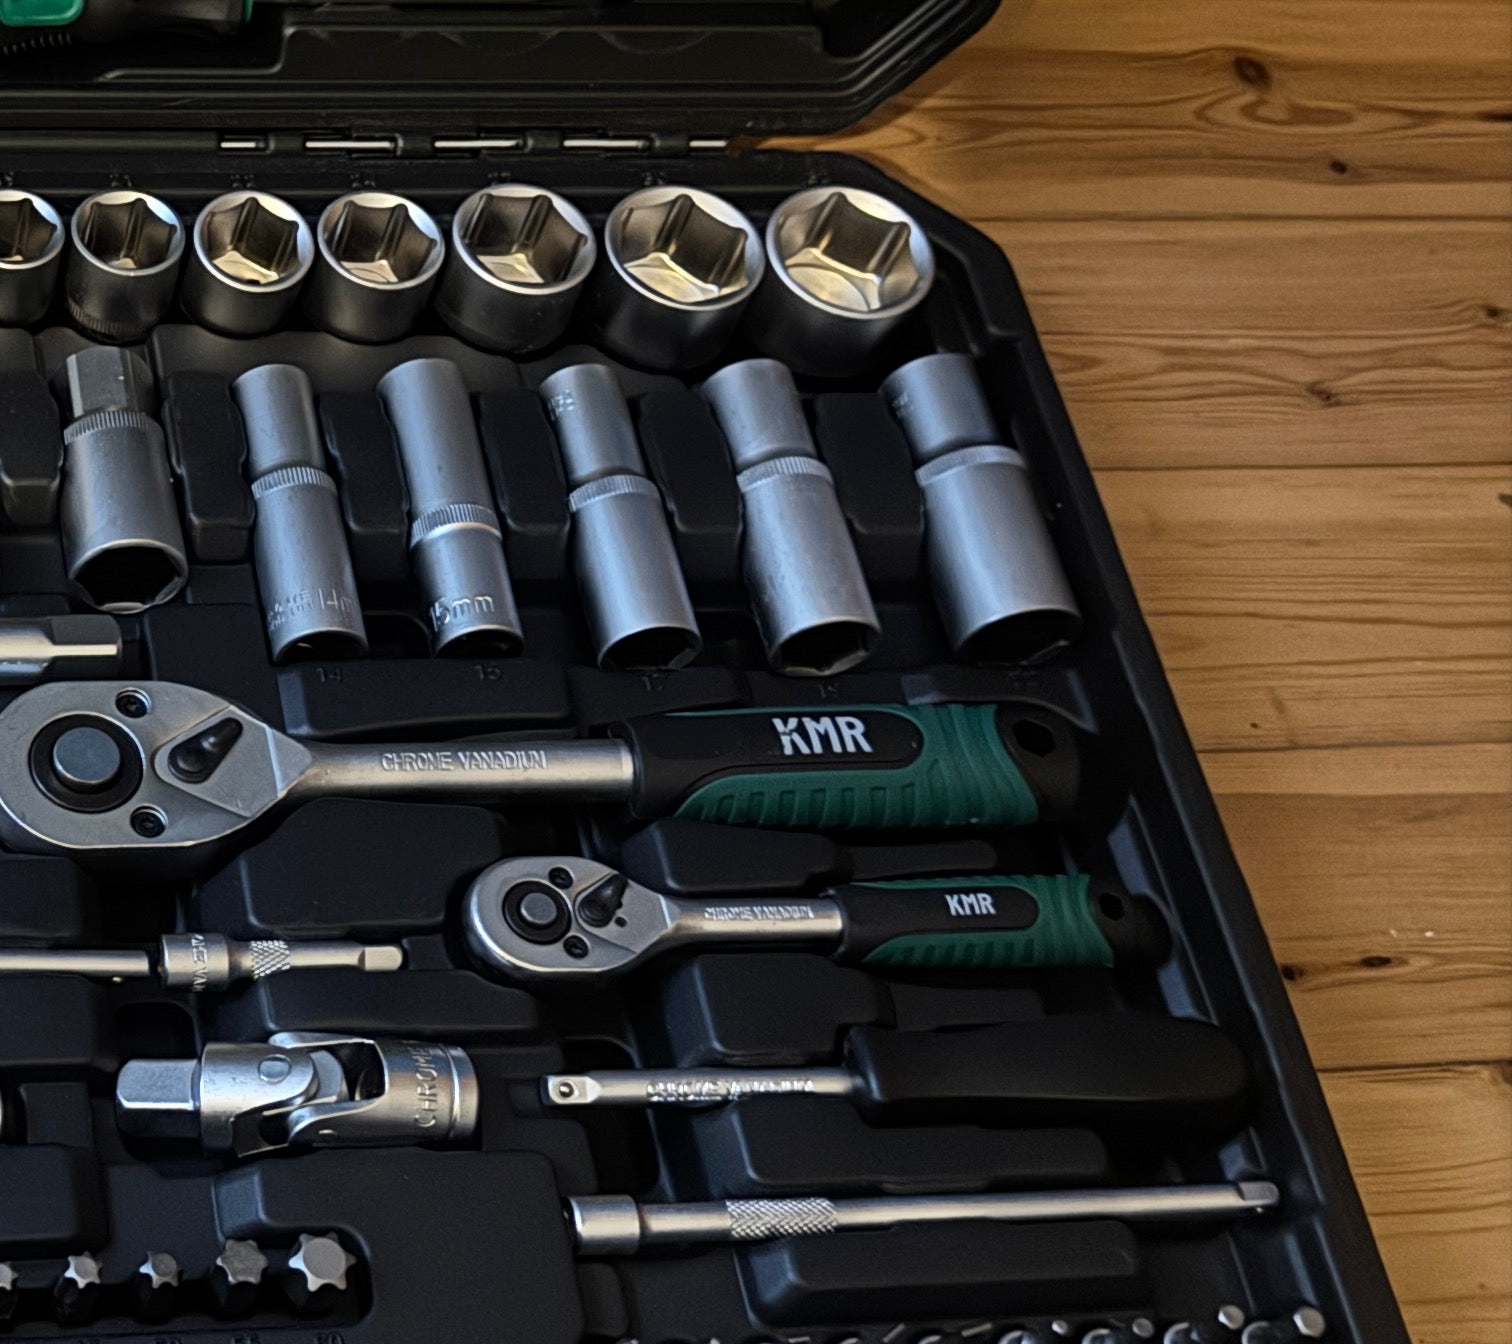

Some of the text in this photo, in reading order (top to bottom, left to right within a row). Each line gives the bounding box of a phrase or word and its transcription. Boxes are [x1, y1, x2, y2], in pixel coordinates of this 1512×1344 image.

[430, 594, 495, 632] 15mm
[772, 714, 874, 756] KMR
[381, 748, 548, 773] CHROME VANADIUM
[944, 891, 997, 917] KMR
[407, 1046, 439, 1128] CHROME
